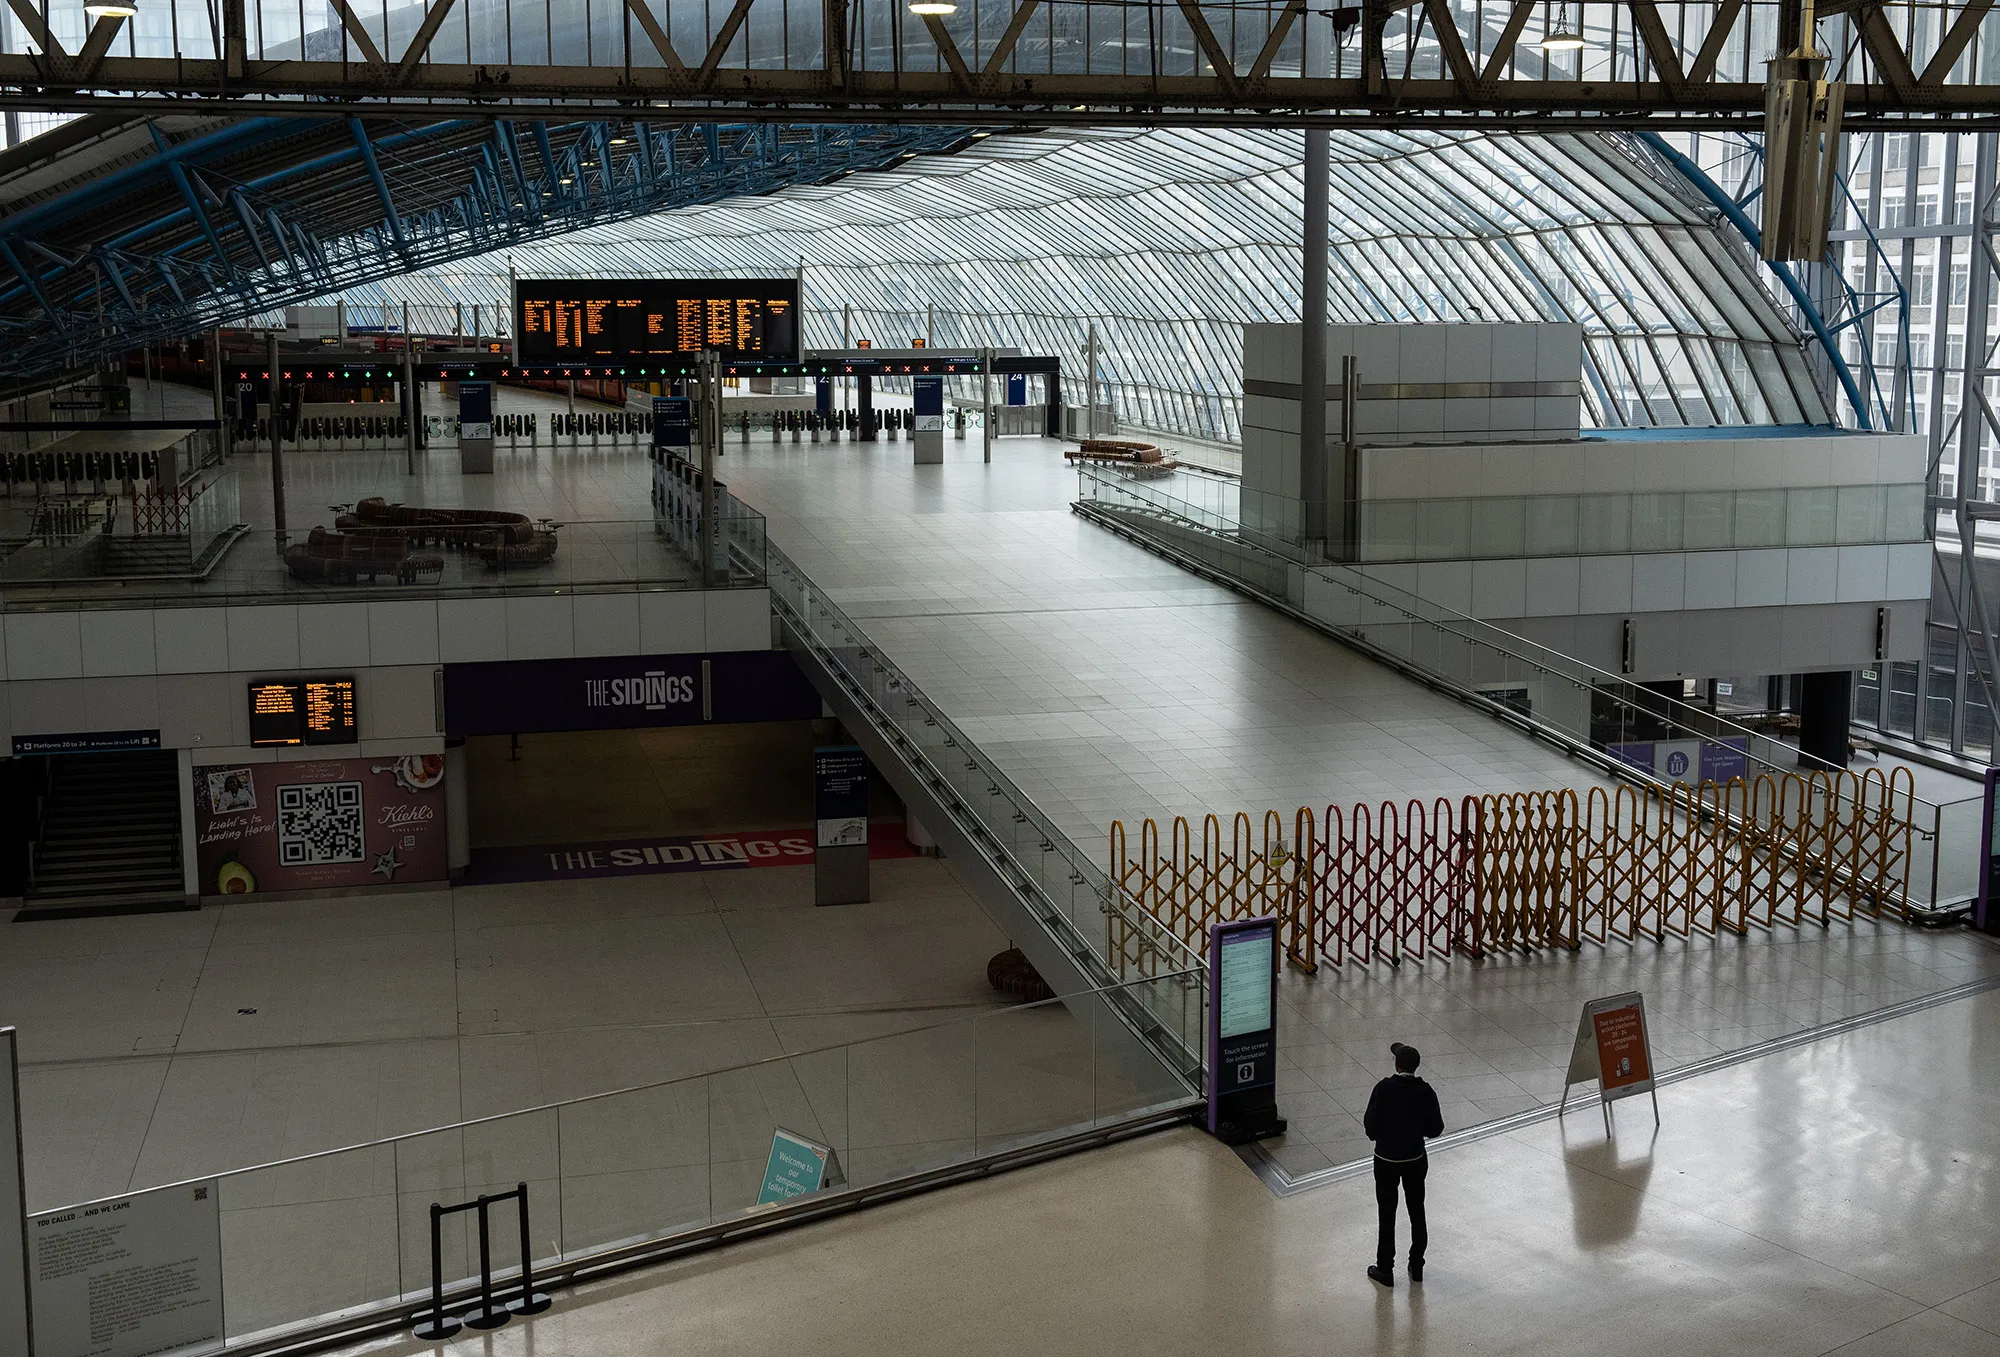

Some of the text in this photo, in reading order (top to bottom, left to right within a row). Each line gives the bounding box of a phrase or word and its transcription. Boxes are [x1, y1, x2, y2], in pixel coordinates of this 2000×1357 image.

[239, 382, 252, 392] 20
[584, 671, 694, 710] THE SIDINGS
[33, 742, 61, 750] Platforms
[208, 814, 262, 832] Kiehl's Is
[377, 804, 433, 824] Kiehl's
[199, 820, 276, 844] Landing Here!
[544, 838, 814, 871] THE SIDINGS
[1224, 1047, 1240, 1055] Touch
[1251, 1042, 1269, 1050] screen
[1235, 1051, 1266, 1062] information
[779, 1151, 806, 1170] Welcome
[806, 1164, 814, 1173] to
[788, 1169, 799, 1178] our
[767, 1182, 784, 1195] toilet
[775, 1174, 807, 1194] temporary
[37, 1219, 50, 1227] YOU
[51, 1213, 76, 1224] CALLED
[85, 1208, 98, 1217] AND
[100, 1205, 111, 1213] WE
[113, 1202, 130, 1211] CAME
